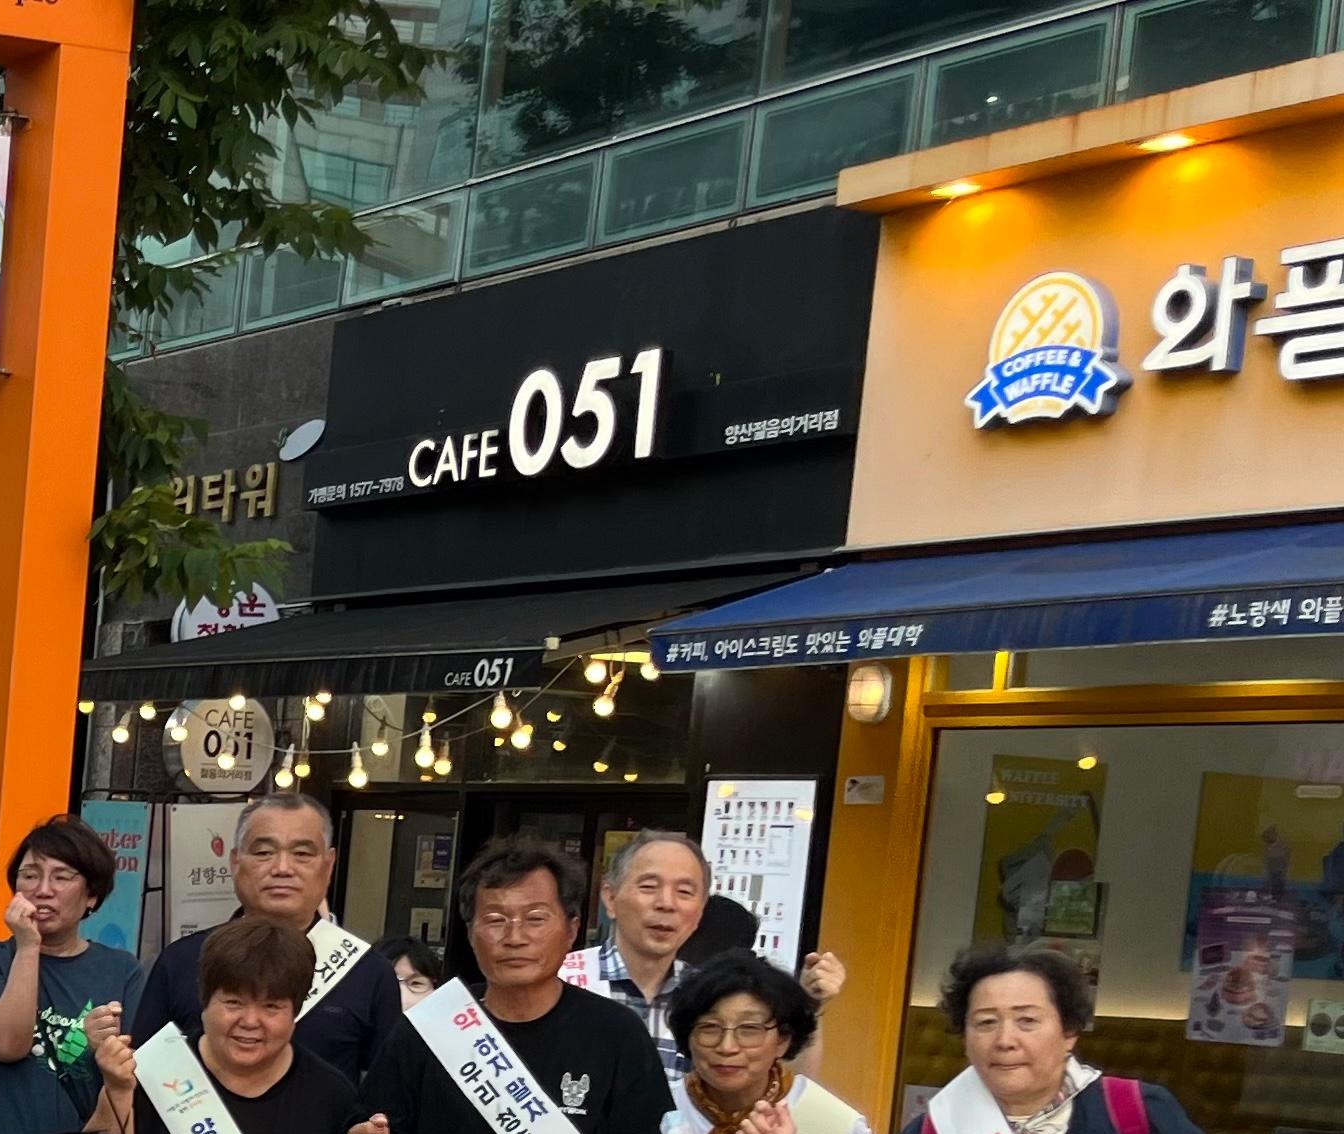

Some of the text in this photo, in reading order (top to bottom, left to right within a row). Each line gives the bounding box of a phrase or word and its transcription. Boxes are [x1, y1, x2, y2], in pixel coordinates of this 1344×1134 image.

[1001, 349, 1067, 376] COFFEE
[1005, 371, 1076, 402] WAFFLE
[408, 348, 664, 488] CAFE 051
[308, 476, 404, 505] 가맹문의 1577-7978
[1207, 598, 1291, 628] #노랑색
[715, 634, 799, 661] 아이스크림도
[805, 630, 852, 656] 맛있는
[857, 624, 924, 650] 와플대학
[444, 657, 514, 688] CAFE 051
[205, 709, 254, 729] CAFE
[99, 829, 141, 850] ater
[453, 1007, 549, 1122] 약 하지 말자
[459, 1061, 500, 1106] 우리
